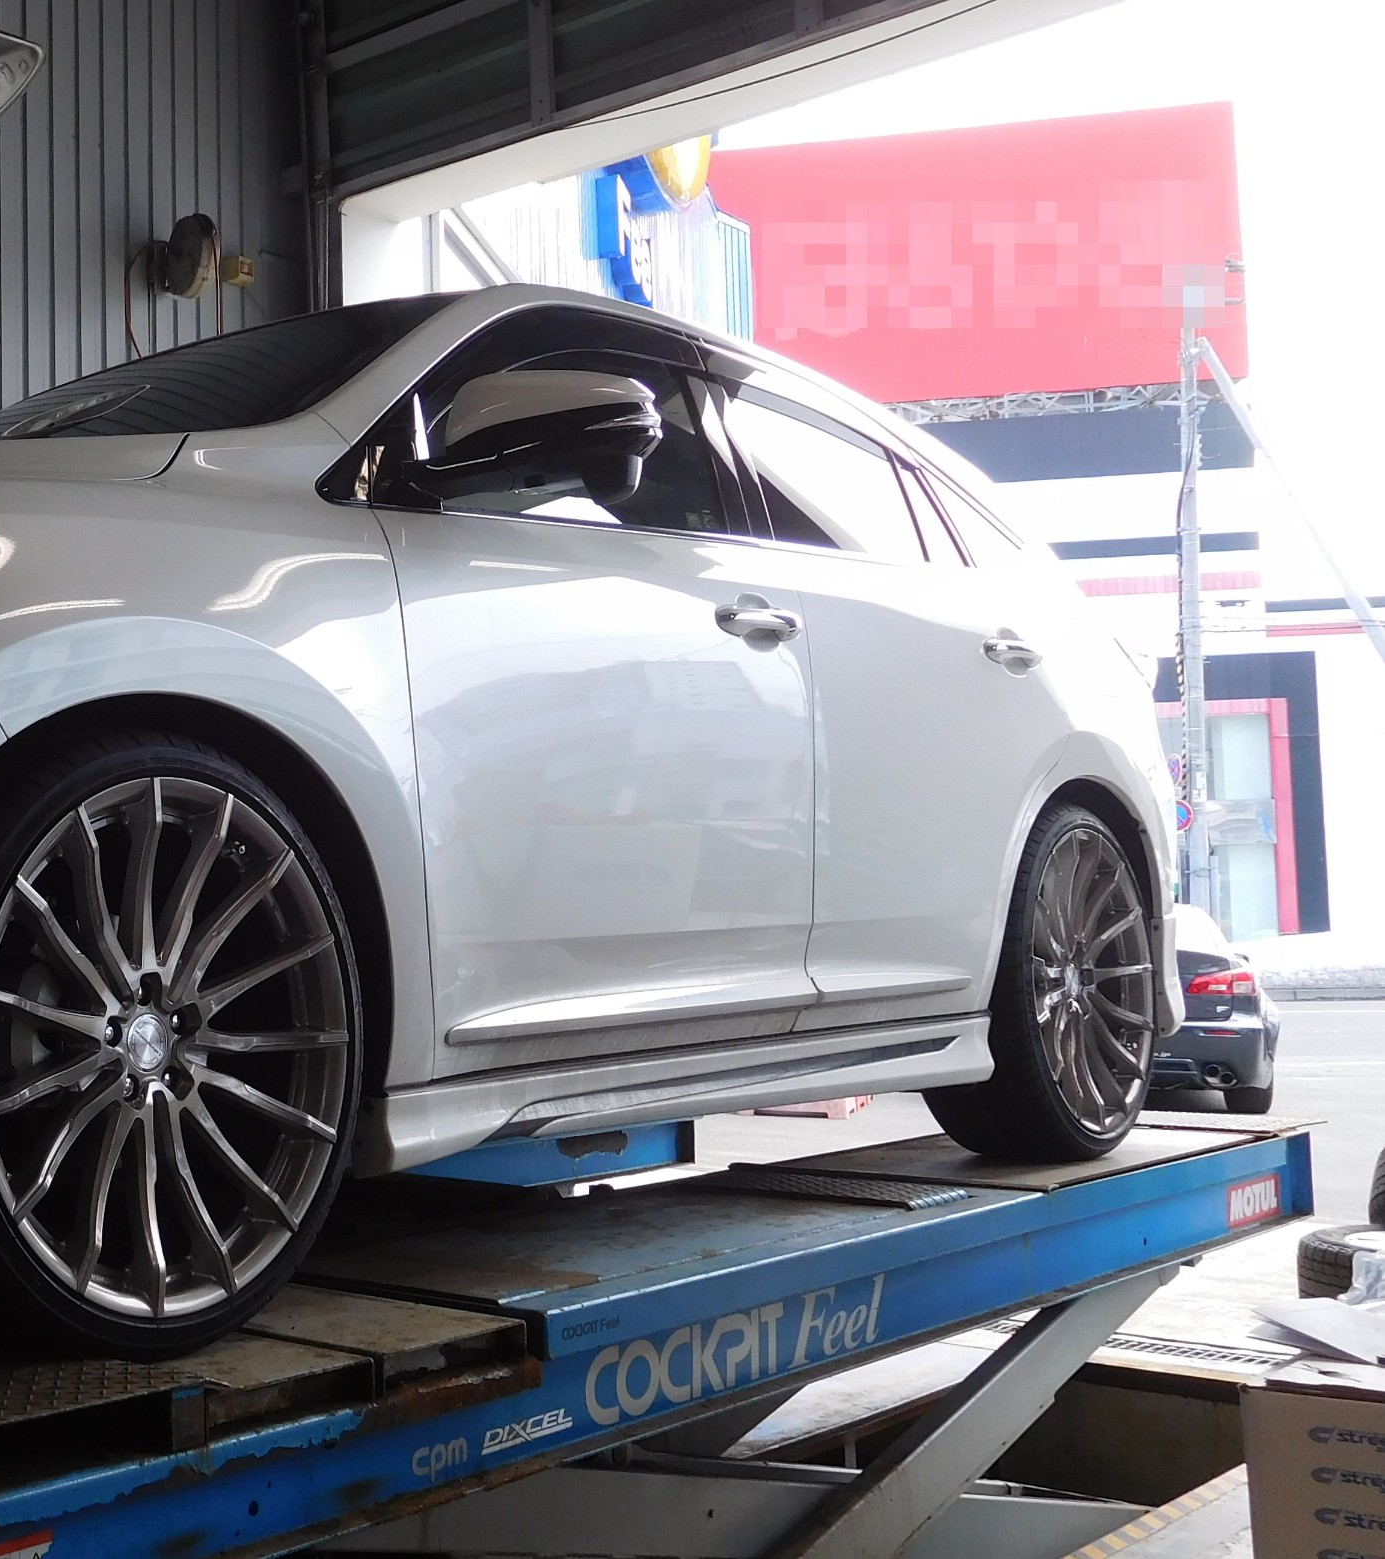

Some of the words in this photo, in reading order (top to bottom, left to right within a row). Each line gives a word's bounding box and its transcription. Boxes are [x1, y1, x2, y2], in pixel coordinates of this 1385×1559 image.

[1229, 1178, 1278, 1222] MOTUL
[562, 1319, 599, 1341] COCKPIT
[585, 1302, 783, 1425] COCKPIT
[788, 1273, 886, 1369] Feel
[482, 1408, 573, 1450] DIXCEL
[411, 1436, 468, 1483] cpm
